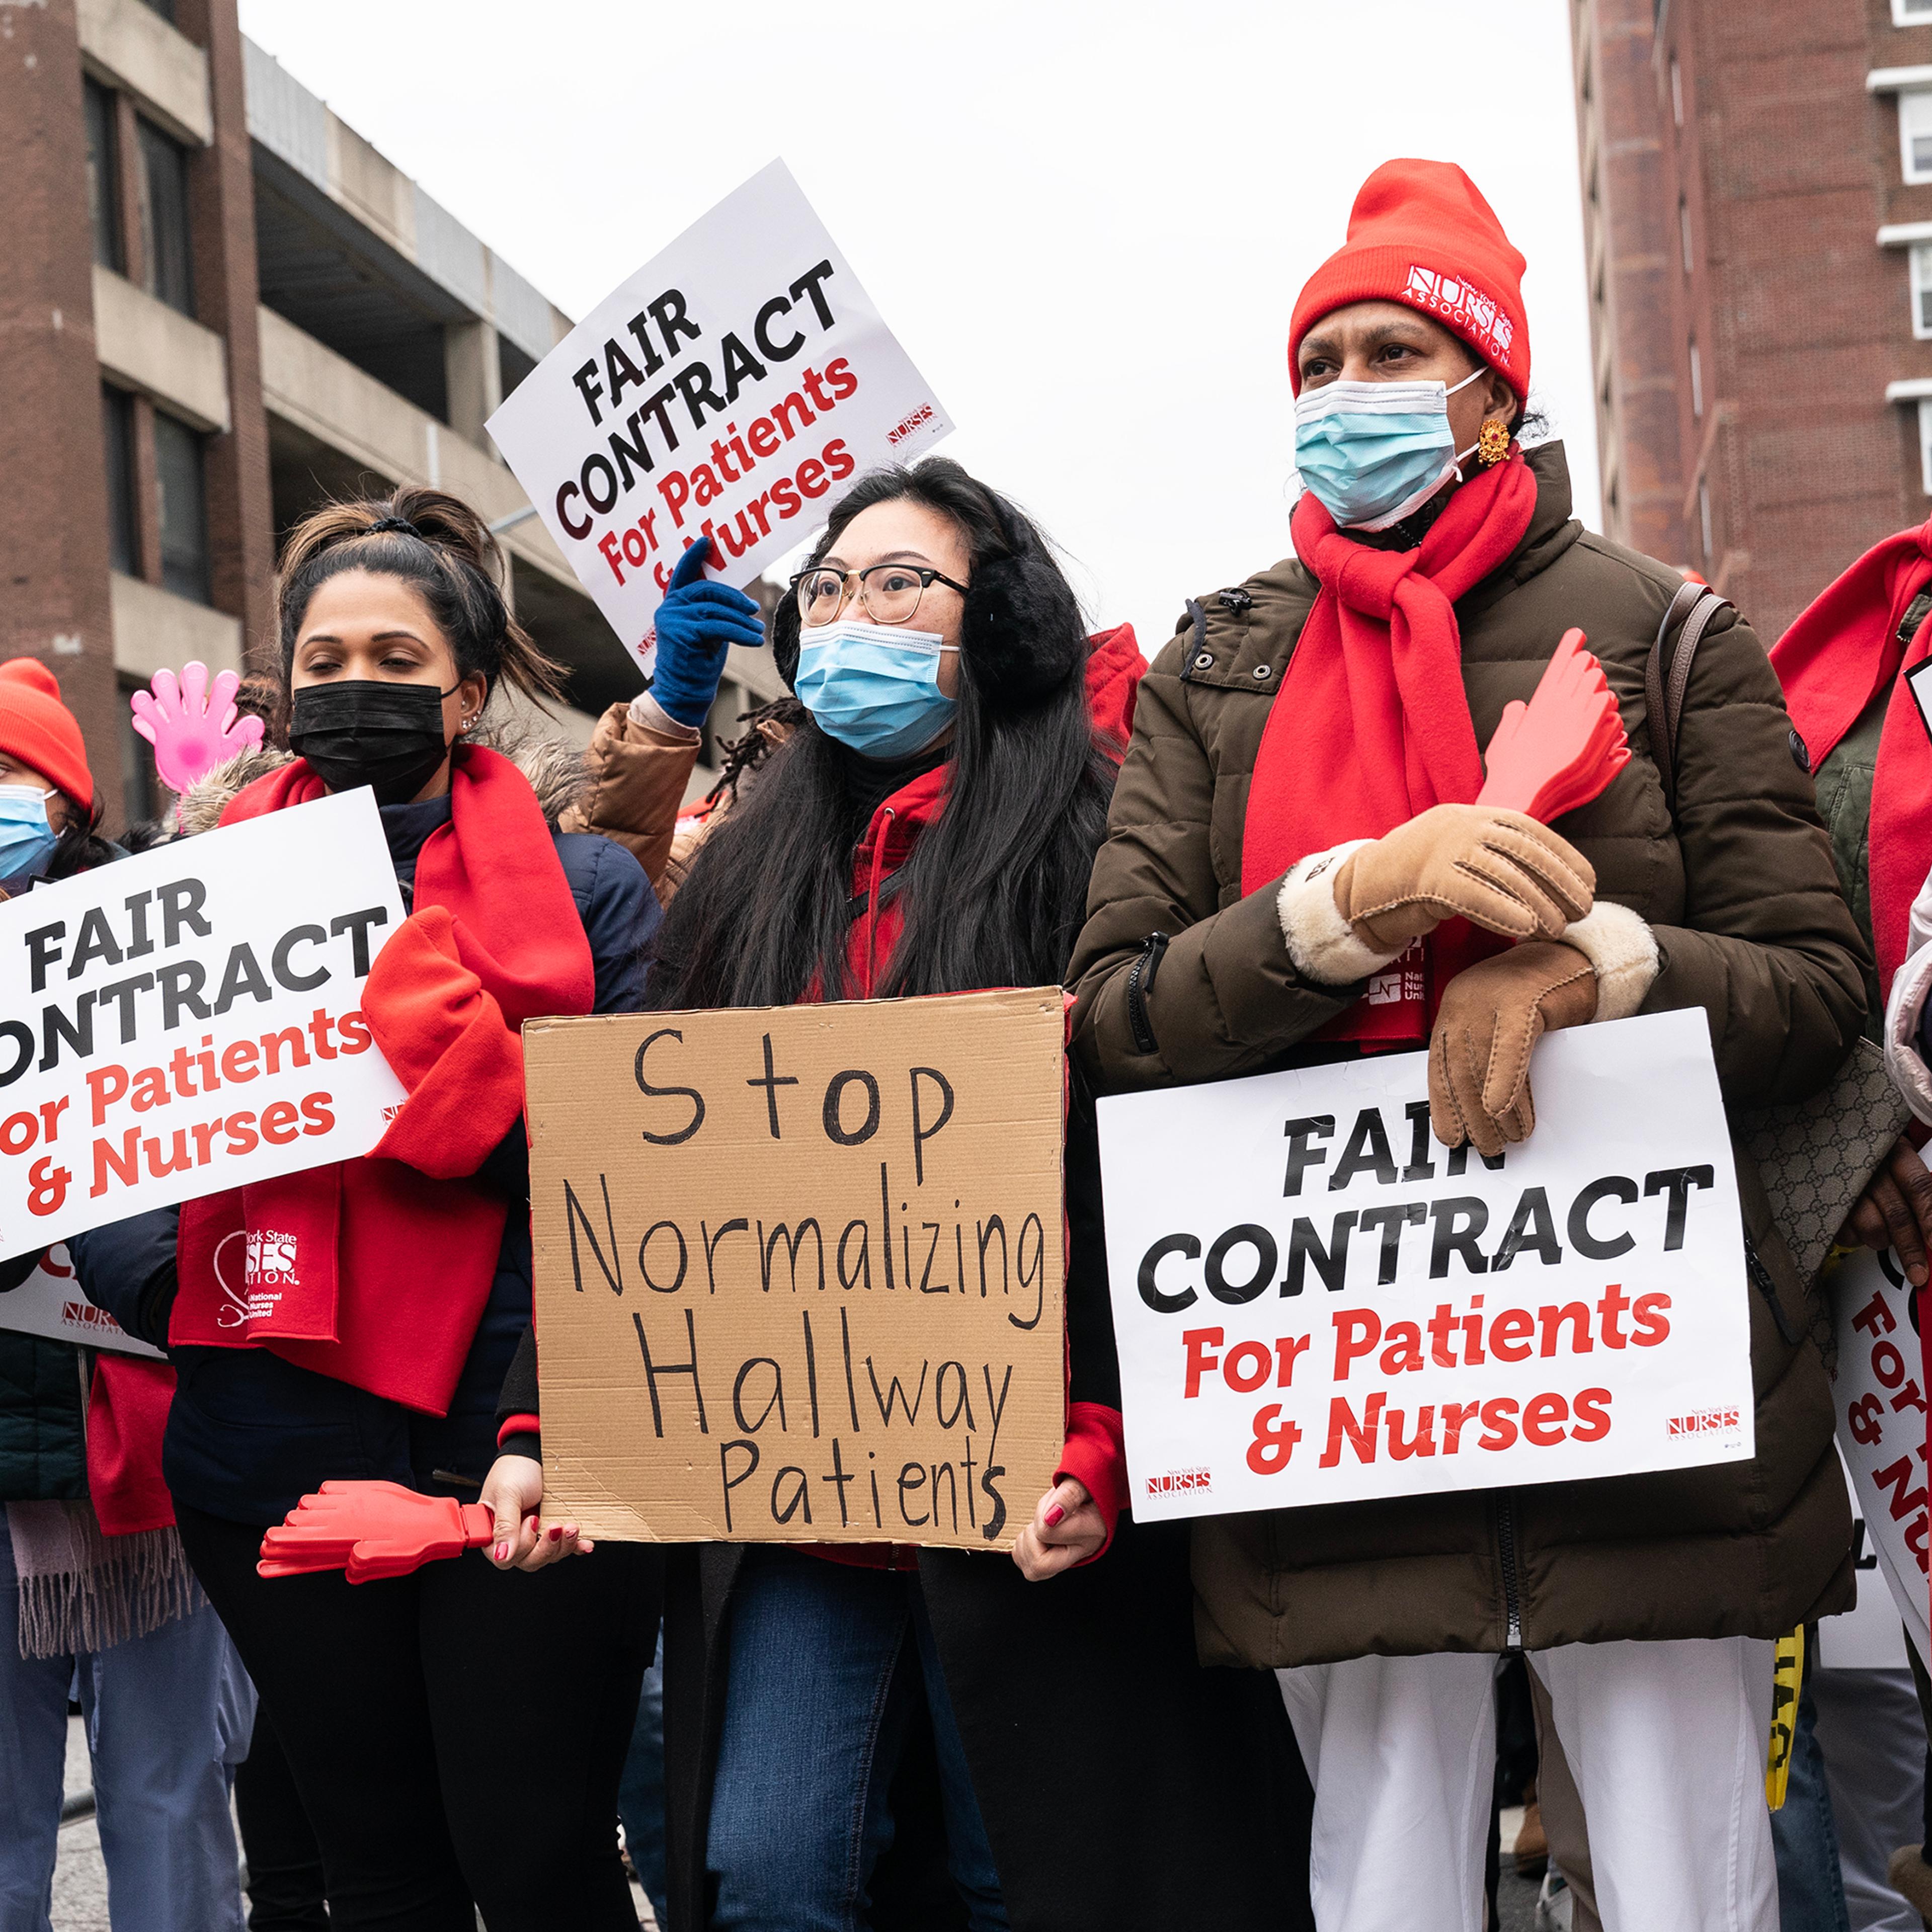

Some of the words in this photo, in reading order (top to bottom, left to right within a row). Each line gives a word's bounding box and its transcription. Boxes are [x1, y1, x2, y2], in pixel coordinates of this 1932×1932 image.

[572, 289, 702, 427] FAIR
[1406, 265, 1512, 350] NURSES
[556, 259, 835, 540] CONTRACT
[886, 406, 933, 446] NURSES
[597, 507, 659, 587] For
[657, 357, 858, 529] Patients
[25, 878, 212, 994] FAIR
[86, 1008, 372, 1127] Patients
[634, 1028, 955, 1187] Stop
[27, 1156, 72, 1217] &
[90, 1092, 335, 1198] Nurses
[265, 1229, 297, 1245] State
[562, 1161, 1044, 1331] Normalizing
[1137, 1164, 1715, 1314] CONTRACT
[633, 1306, 1013, 1466] Hallway
[1182, 1326, 1311, 1399] For
[1332, 1284, 1671, 1381] Patients
[1852, 1290, 1927, 1413] For
[1246, 1403, 1302, 1475] &
[1319, 1388, 1612, 1469] Nurses
[1666, 1411, 1740, 1435] NURSES
[1667, 1426, 1741, 1441] ASSOCIATION
[1848, 1392, 1885, 1447] &
[719, 1435, 1006, 1541] Patients
[1145, 1472, 1212, 1494] NURSES
[1147, 1485, 1214, 1500] ASSOCIATION
